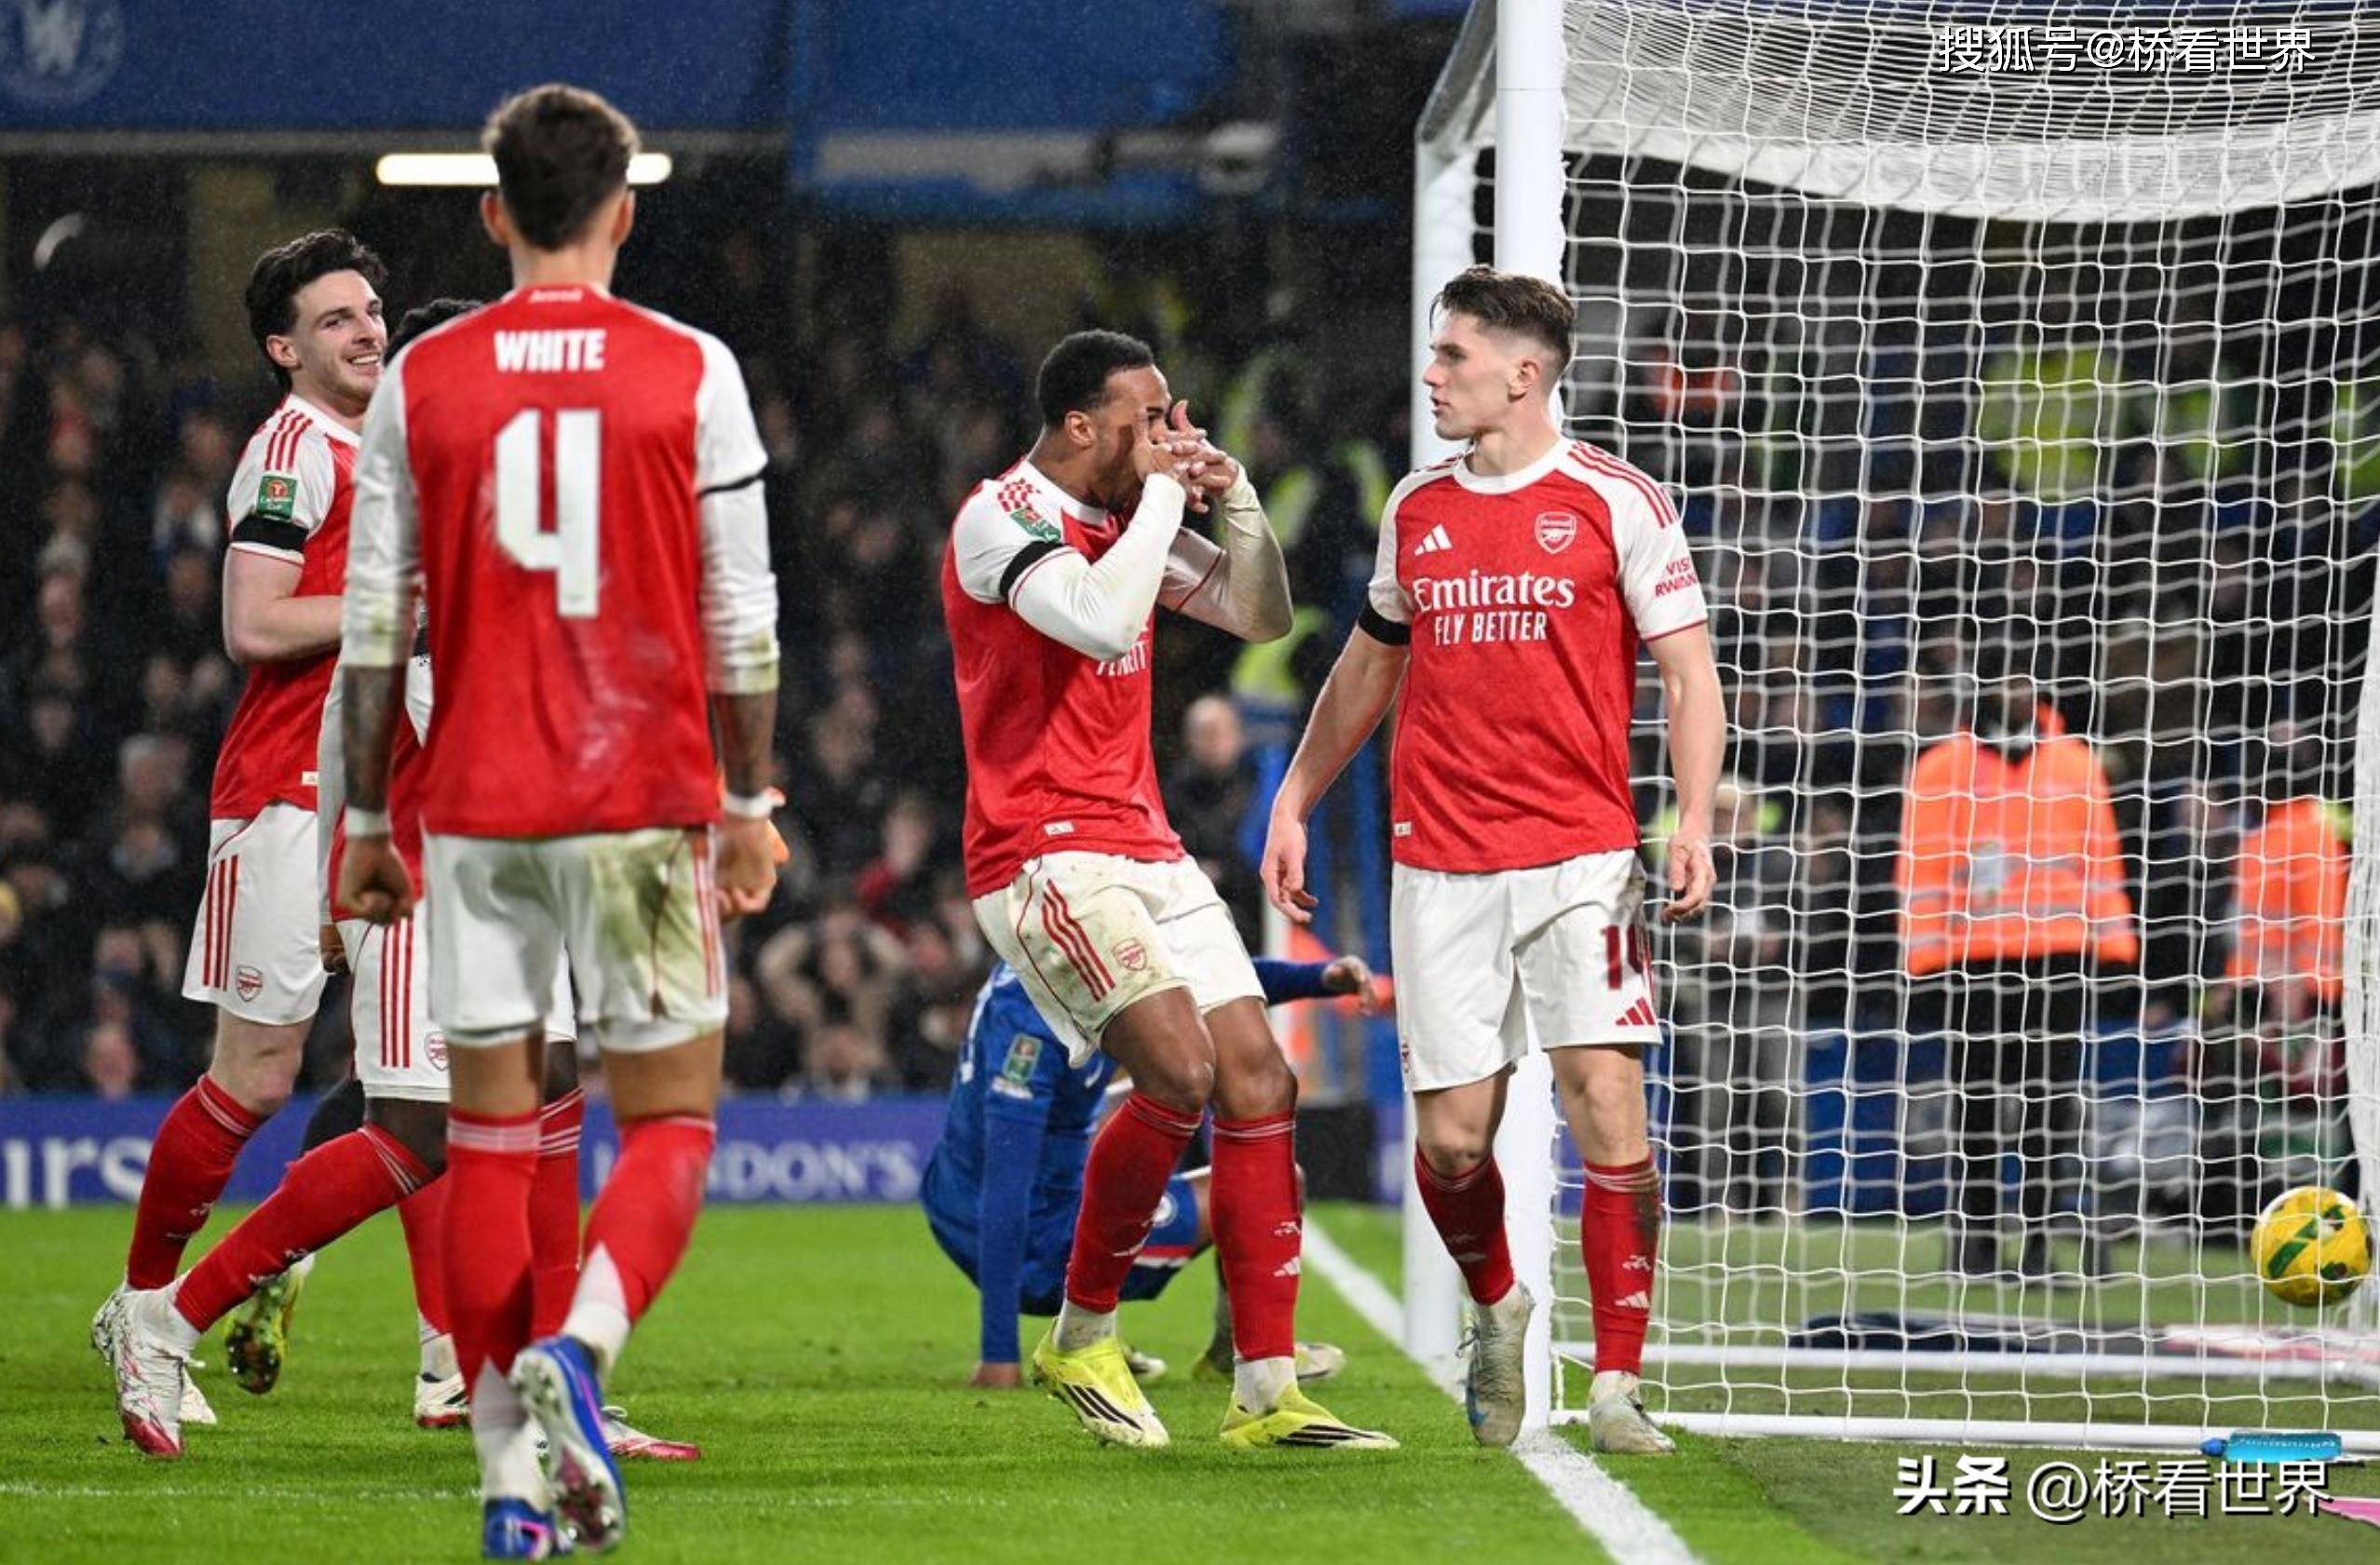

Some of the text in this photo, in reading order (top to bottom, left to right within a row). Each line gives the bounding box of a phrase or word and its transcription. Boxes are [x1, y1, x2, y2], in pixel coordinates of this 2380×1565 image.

[494, 329, 607, 372] WHITE
[495, 408, 602, 618] 4
[1413, 569, 1575, 613] Emirates
[1435, 611, 1548, 646] FLY BETTER
[593, 1139, 922, 1201] LDON'S
